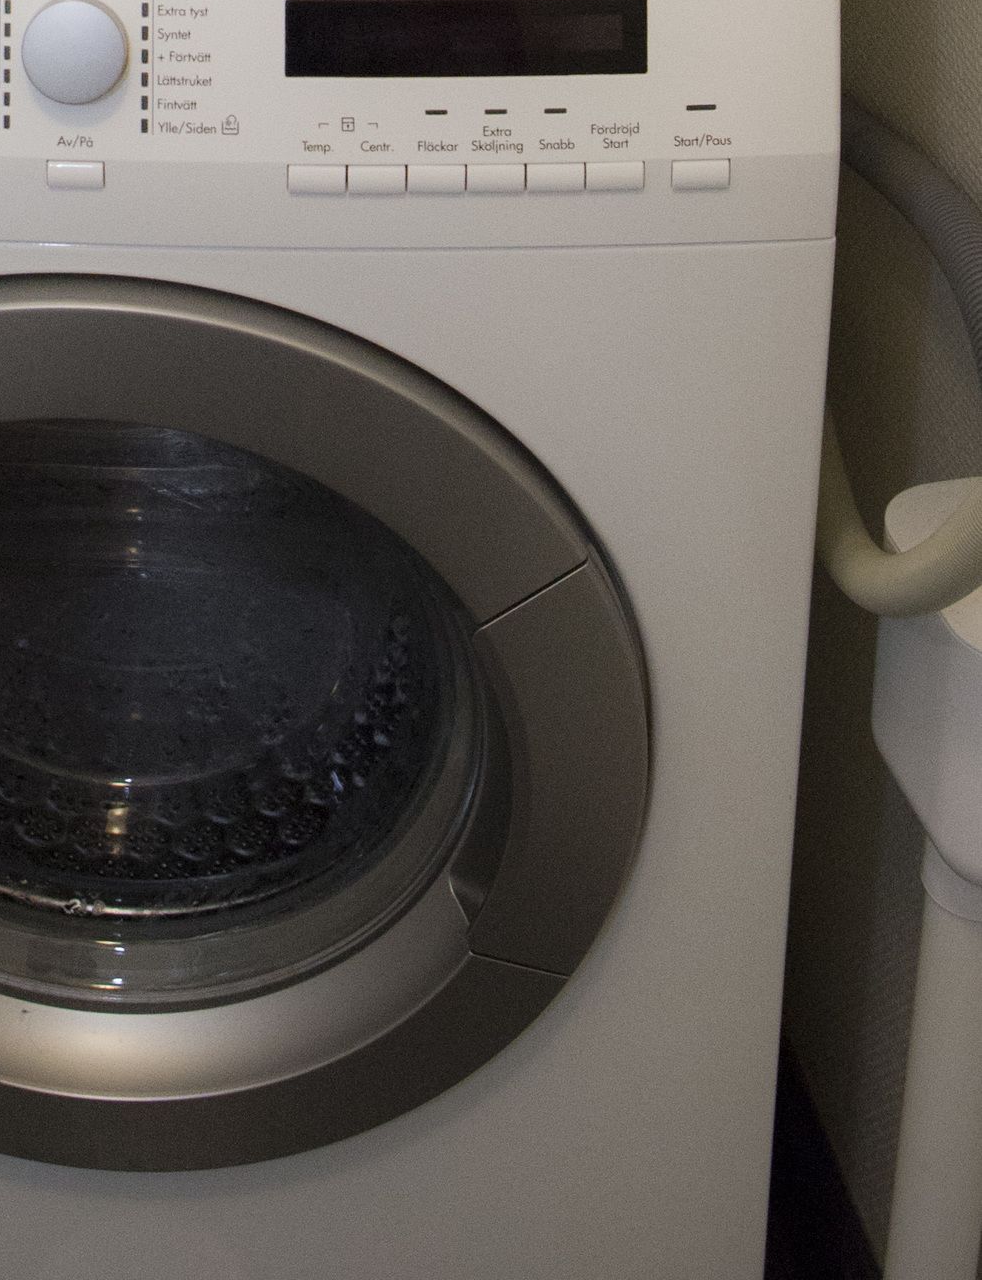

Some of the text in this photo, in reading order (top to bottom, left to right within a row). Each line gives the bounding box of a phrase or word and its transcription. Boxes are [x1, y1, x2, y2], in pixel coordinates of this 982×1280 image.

[158, 5, 208, 20] Extra tyst
[158, 28, 191, 42] Syntet
[170, 51, 211, 62] Förtvätt
[157, 75, 212, 87] Lättstruket
[157, 99, 197, 111] Fintvätt
[158, 122, 217, 135] Ylle/Siden
[482, 126, 511, 137] Extra
[591, 122, 640, 136] Fördröjd
[57, 135, 94, 148] Av/På
[302, 140, 334, 153] Temp.
[360, 140, 393, 152] Centr.
[418, 140, 458, 152] Fläckar
[471, 138, 524, 154] Sköljning
[539, 138, 575, 150] Snabb
[603, 138, 629, 149] Start
[674, 134, 731, 148] Start/Paus
